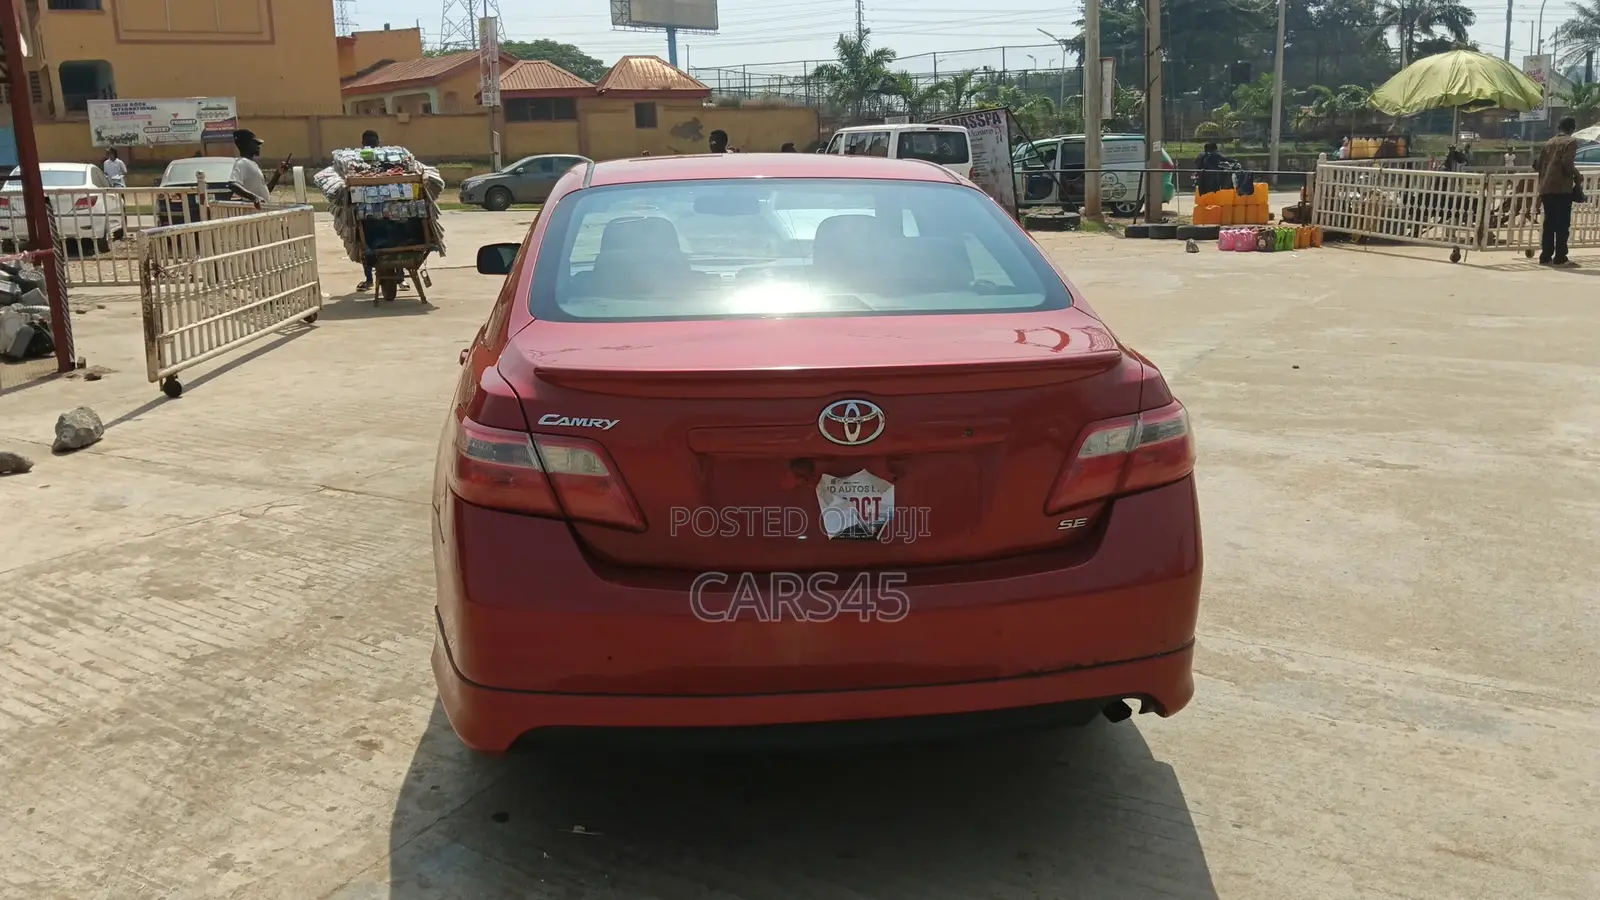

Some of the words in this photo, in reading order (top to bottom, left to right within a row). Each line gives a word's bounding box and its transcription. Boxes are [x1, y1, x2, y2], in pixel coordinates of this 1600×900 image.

[538, 413, 620, 430] CAMRY
[839, 485, 870, 493] AUTOS
[1058, 517, 1088, 530] SE
